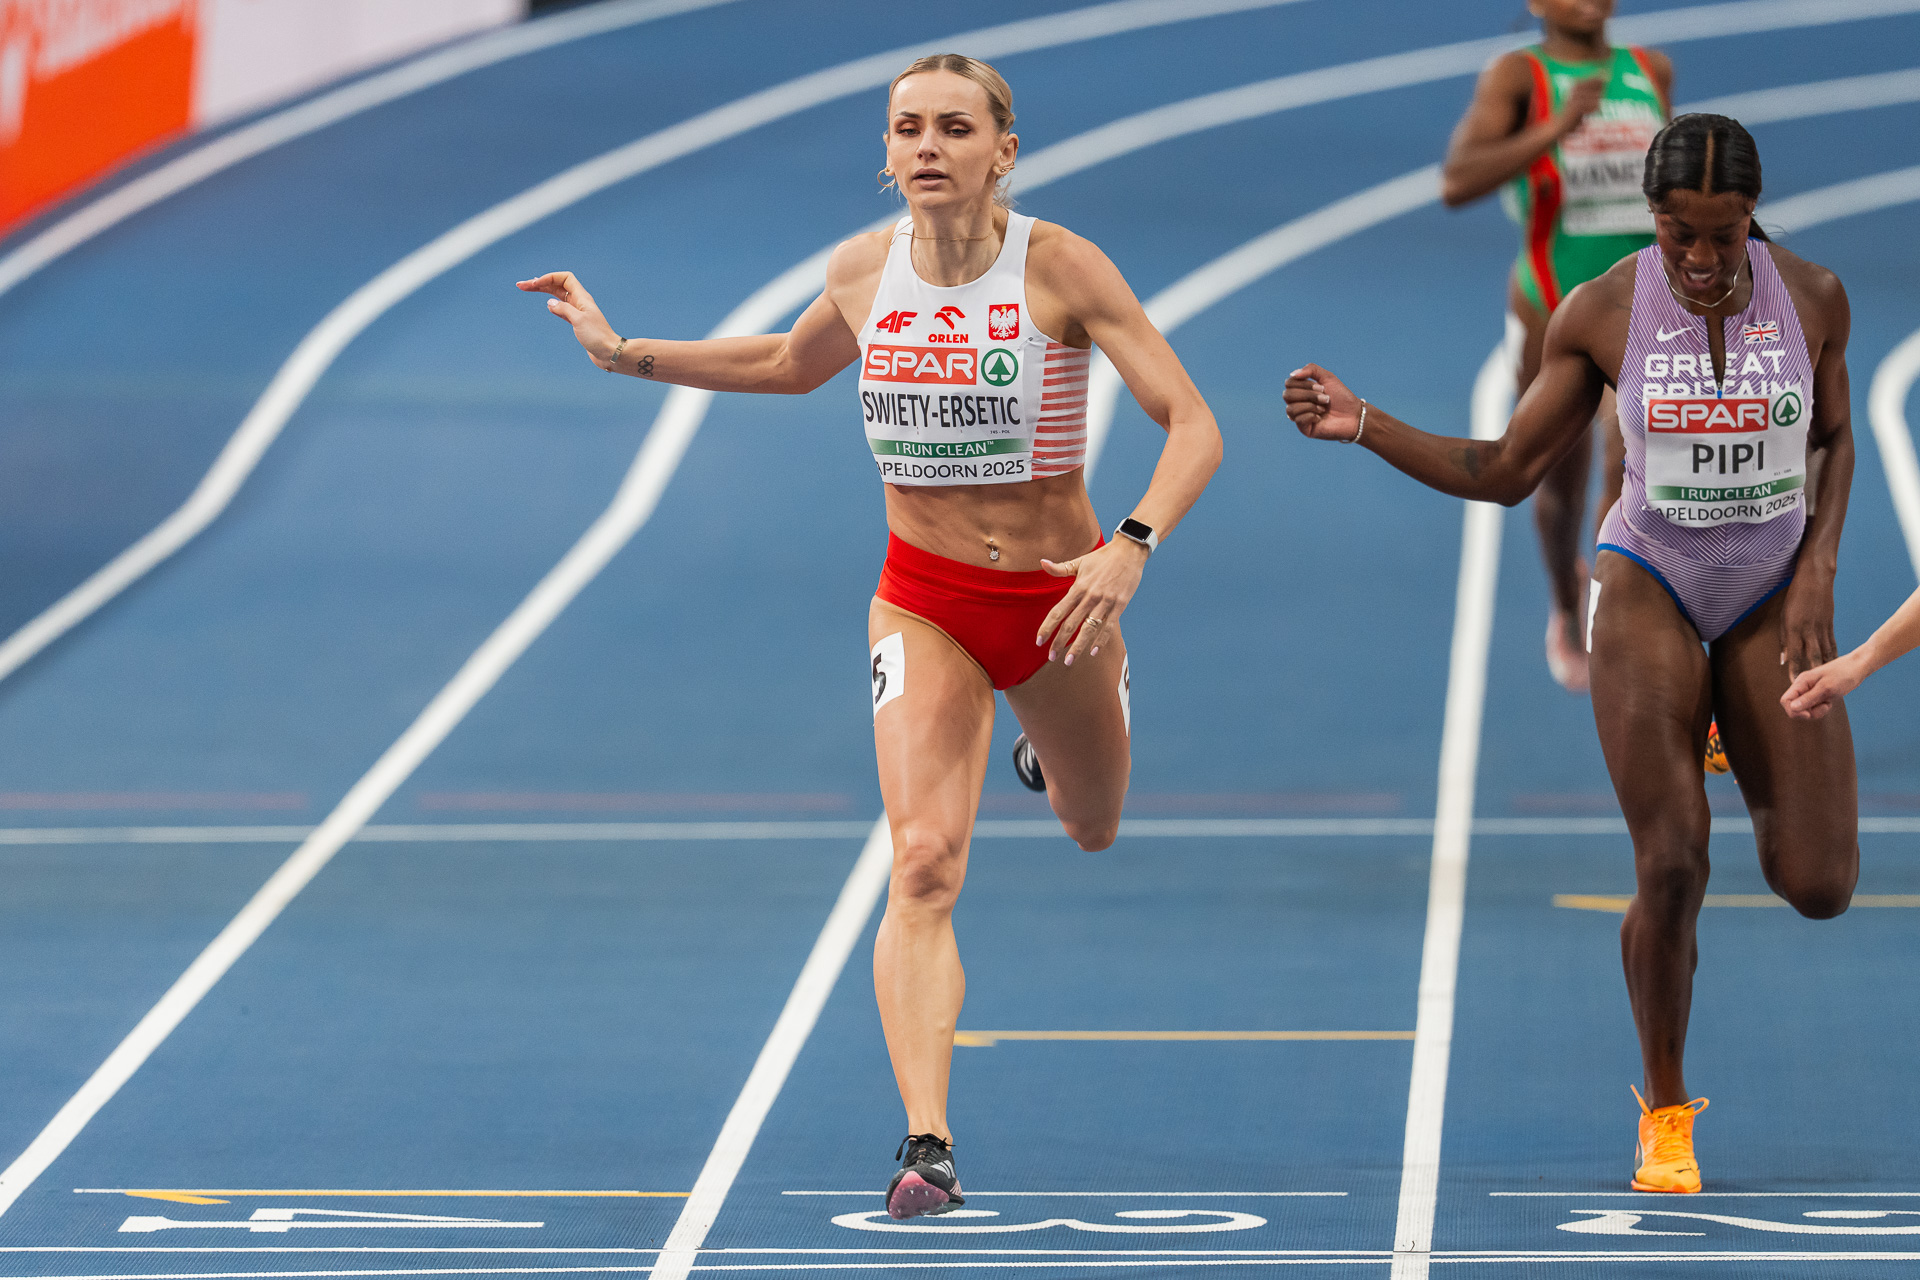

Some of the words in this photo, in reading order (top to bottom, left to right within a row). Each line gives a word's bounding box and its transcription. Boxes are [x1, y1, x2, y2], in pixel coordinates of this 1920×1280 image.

[876, 310, 918, 333] 4F
[928, 333, 969, 344] ORLEN
[867, 350, 974, 380] SPAR
[1644, 351, 1785, 378] GREAT
[862, 390, 1021, 428] SWIETY-ERSETIC
[1651, 403, 1766, 429] SPAR
[902, 444, 933, 456] RUN
[1692, 441, 1764, 475] PIPI
[982, 459, 1025, 477] 2025
[1688, 488, 1721, 500] RUN
[1765, 492, 1798, 515] 2025
[873, 652, 886, 704] 5
[117, 1208, 545, 1233] 4
[830, 1209, 1268, 1234] 3
[1556, 1209, 1920, 1236] 2
